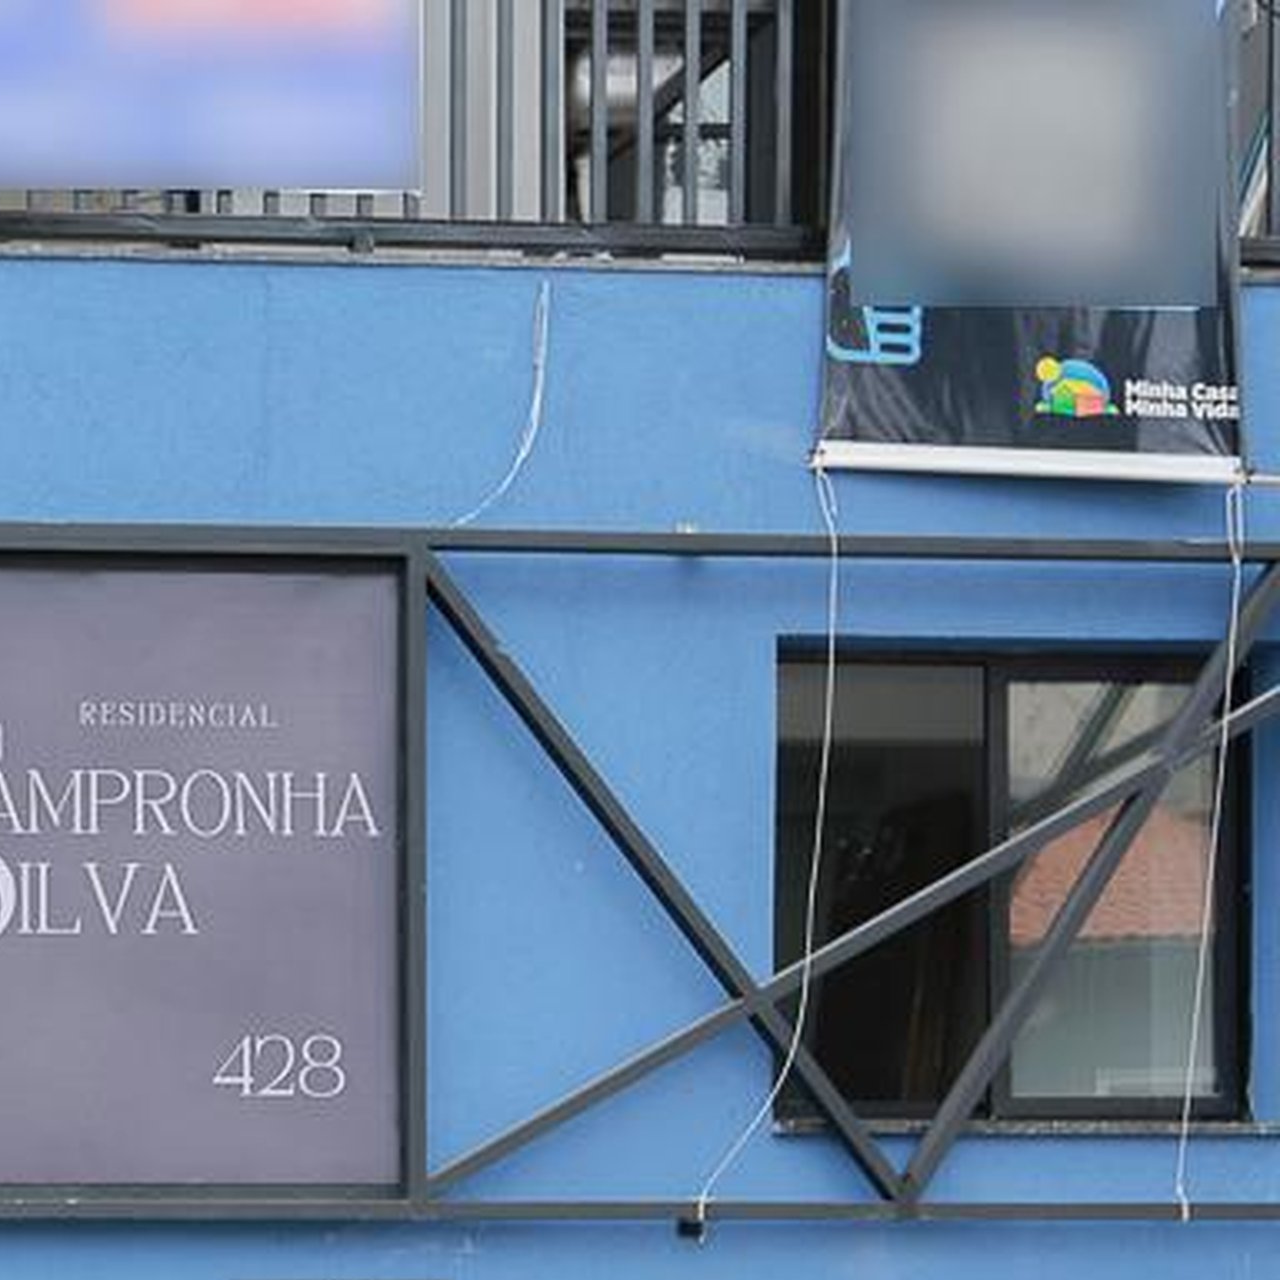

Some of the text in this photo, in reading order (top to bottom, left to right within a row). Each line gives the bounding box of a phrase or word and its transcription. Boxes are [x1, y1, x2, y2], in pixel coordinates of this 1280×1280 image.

[1125, 378, 1187, 400] Minha
[1125, 398, 1187, 417] Minha
[79, 700, 276, 728] RESIDENCIAL
[212, 1033, 346, 1099] 428
